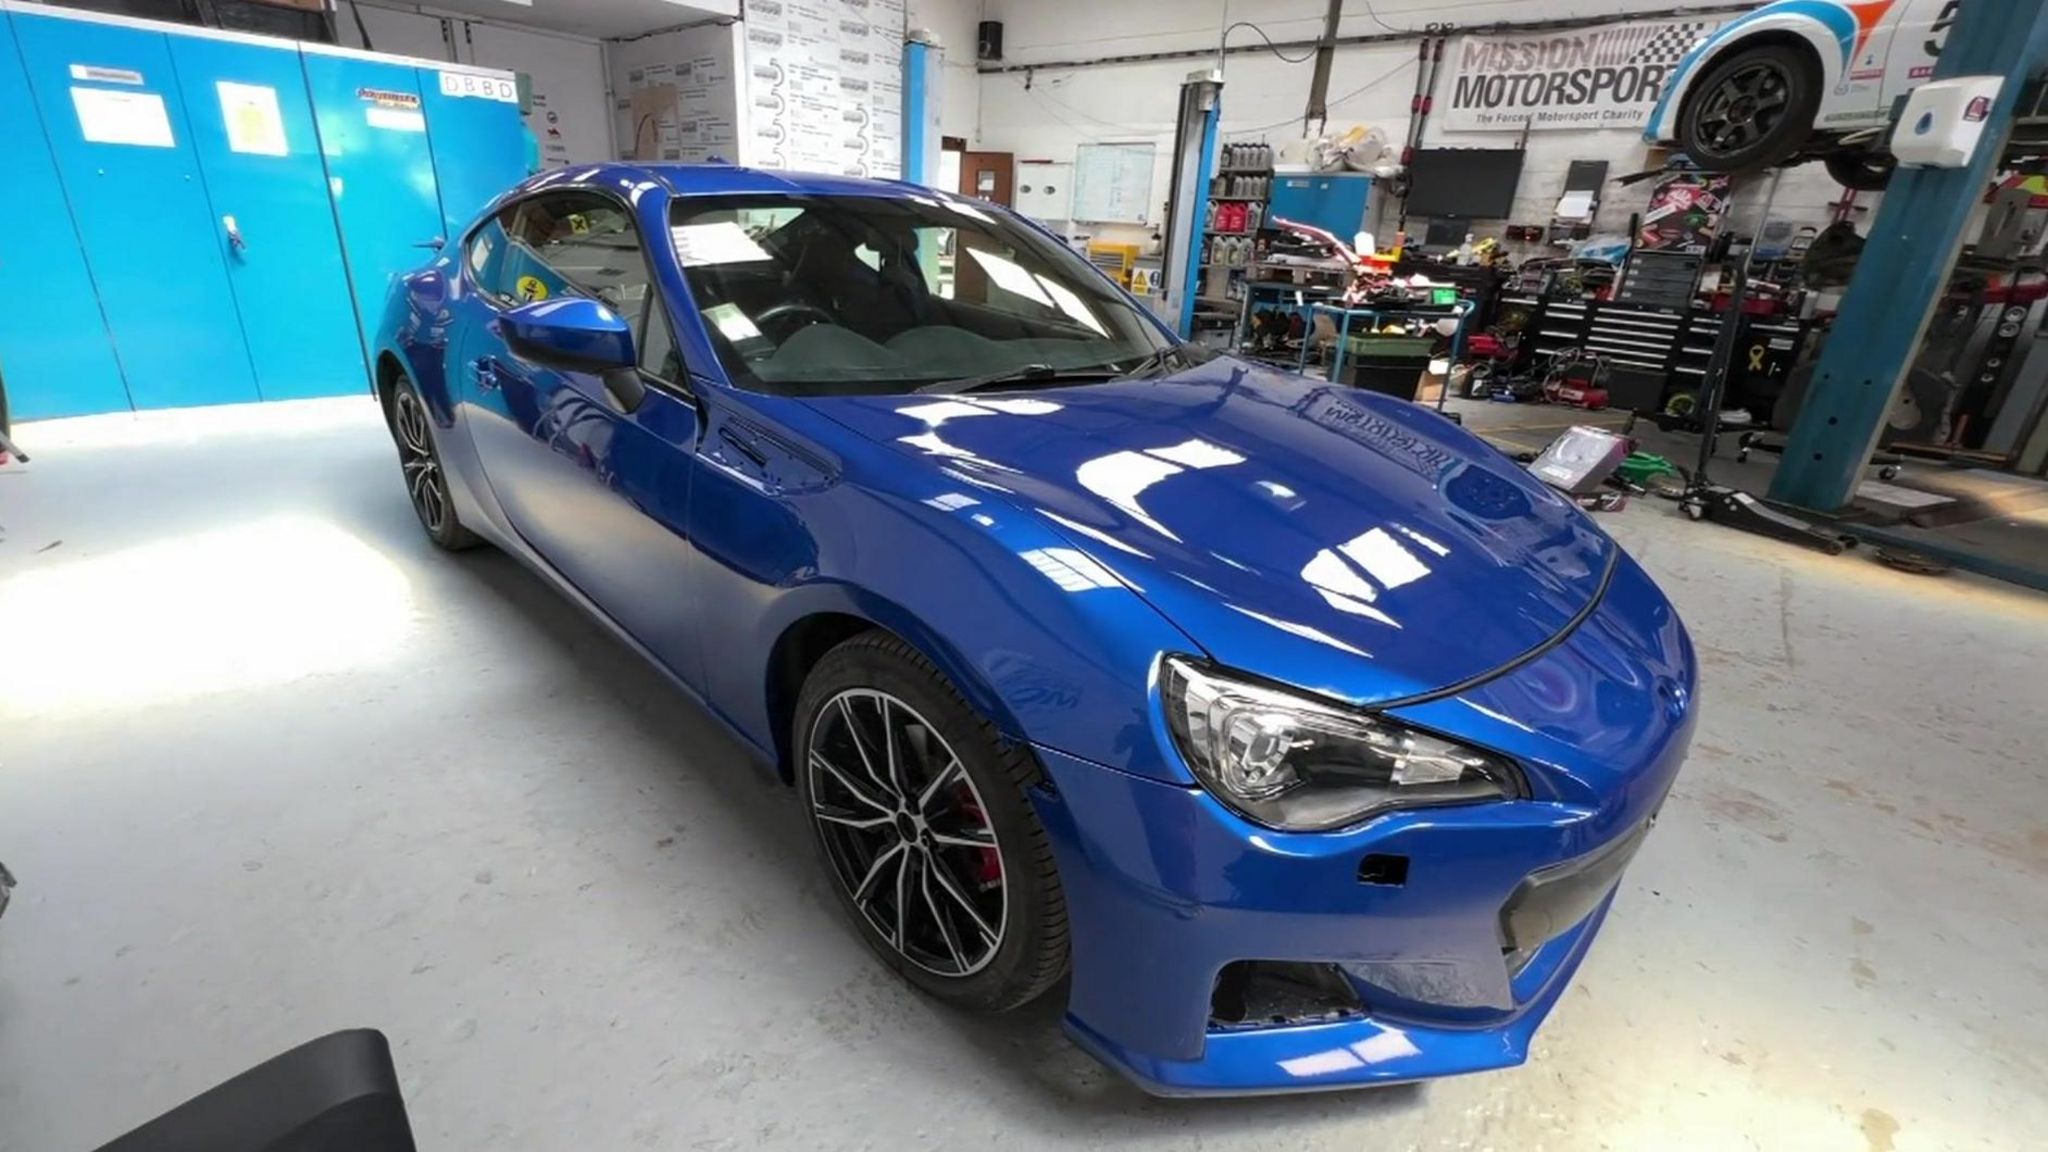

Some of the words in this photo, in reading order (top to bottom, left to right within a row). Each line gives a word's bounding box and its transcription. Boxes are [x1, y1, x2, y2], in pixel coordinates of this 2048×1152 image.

[1461, 34, 1602, 73] MISSION
[1477, 113, 1493, 123] The
[1537, 111, 1599, 122] Motorsport
[1602, 109, 1643, 121] Charity
